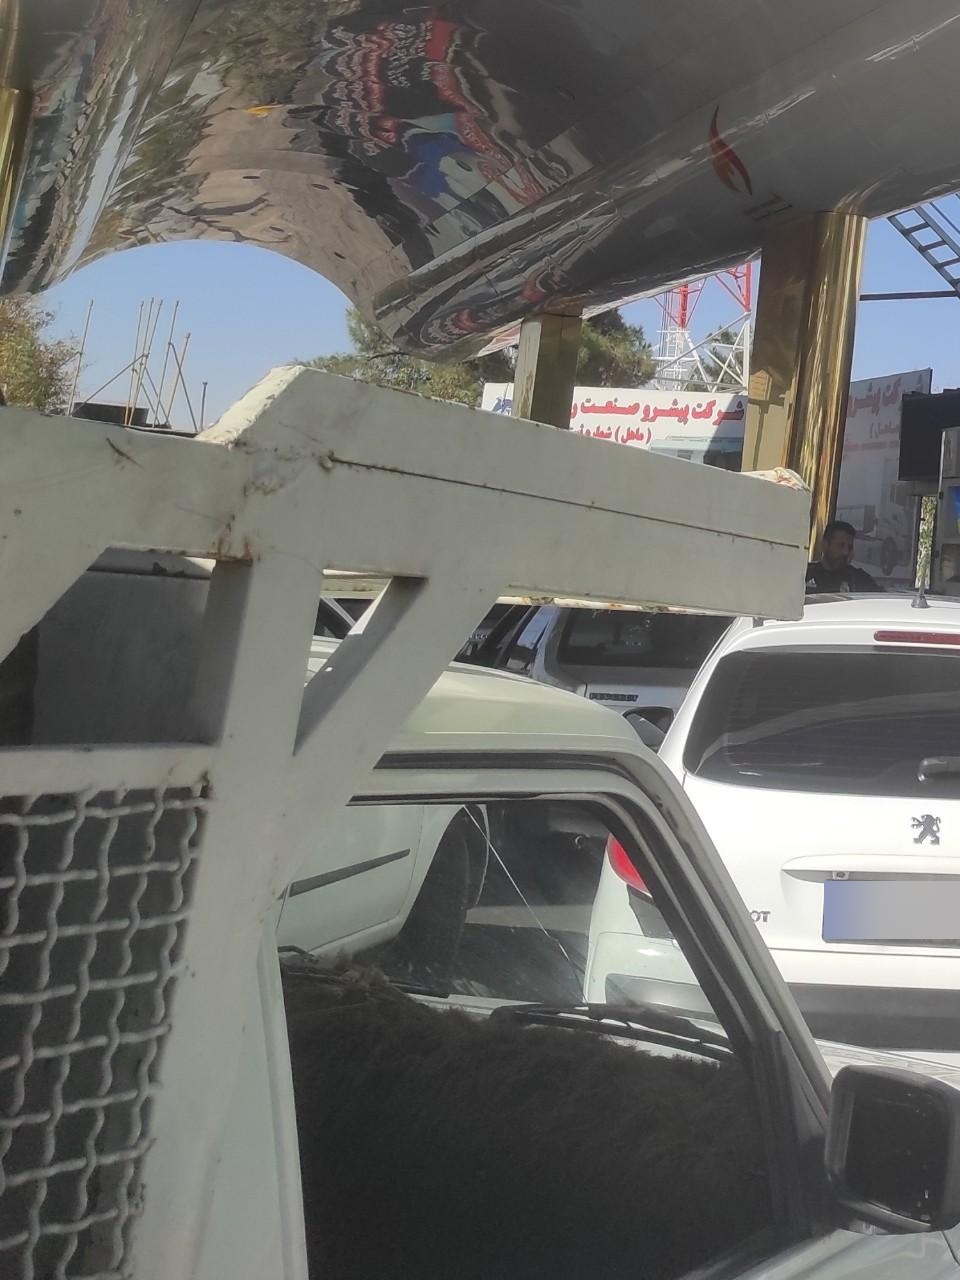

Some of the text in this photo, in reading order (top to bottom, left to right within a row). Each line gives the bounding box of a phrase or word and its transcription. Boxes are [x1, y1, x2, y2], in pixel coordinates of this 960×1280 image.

[580, 397, 640, 416] صنعت
[640, 398, 690, 425] پیشرو
[691, 399, 745, 425] شرکت
